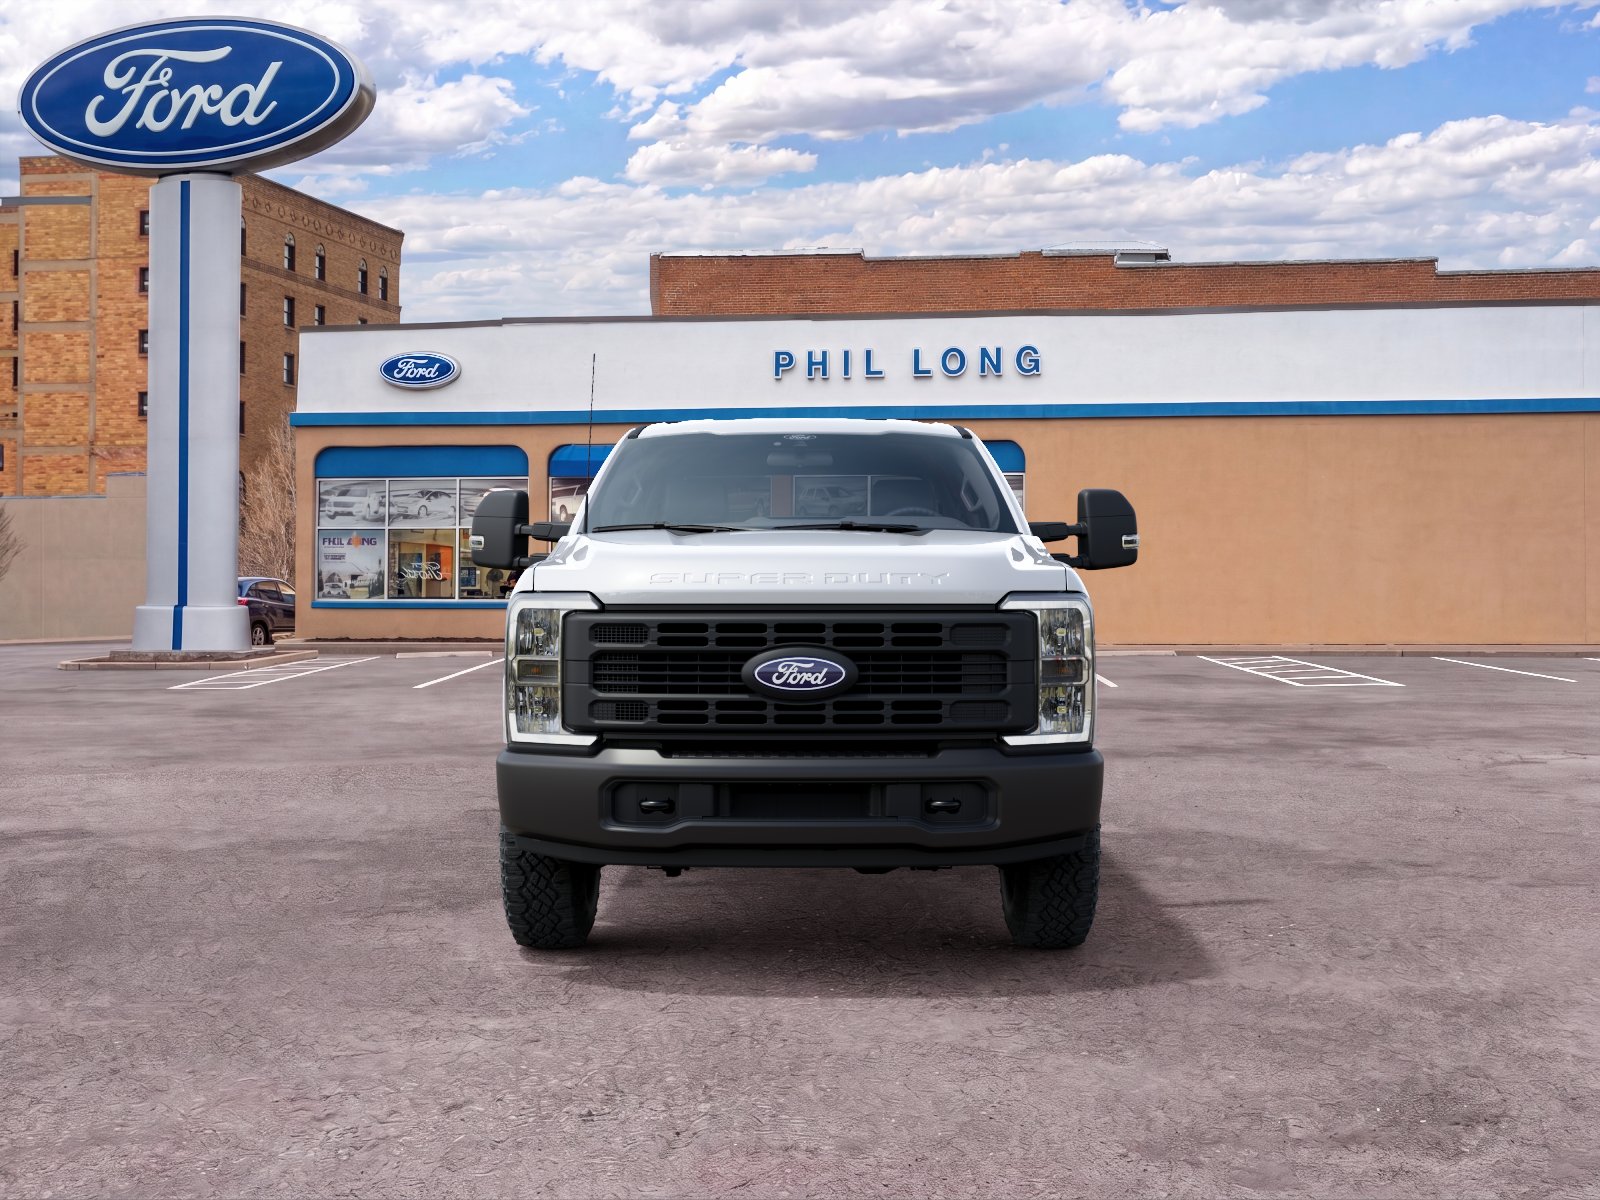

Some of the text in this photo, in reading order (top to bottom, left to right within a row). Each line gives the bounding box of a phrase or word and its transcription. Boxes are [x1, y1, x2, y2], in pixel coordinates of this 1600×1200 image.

[84, 45, 283, 138] Ford
[393, 358, 440, 379] Ford
[773, 344, 1041, 380] PHIL LONG
[346, 537, 377, 546] LNG
[650, 572, 950, 585] SUPER DUTY
[772, 661, 828, 685] Ford
